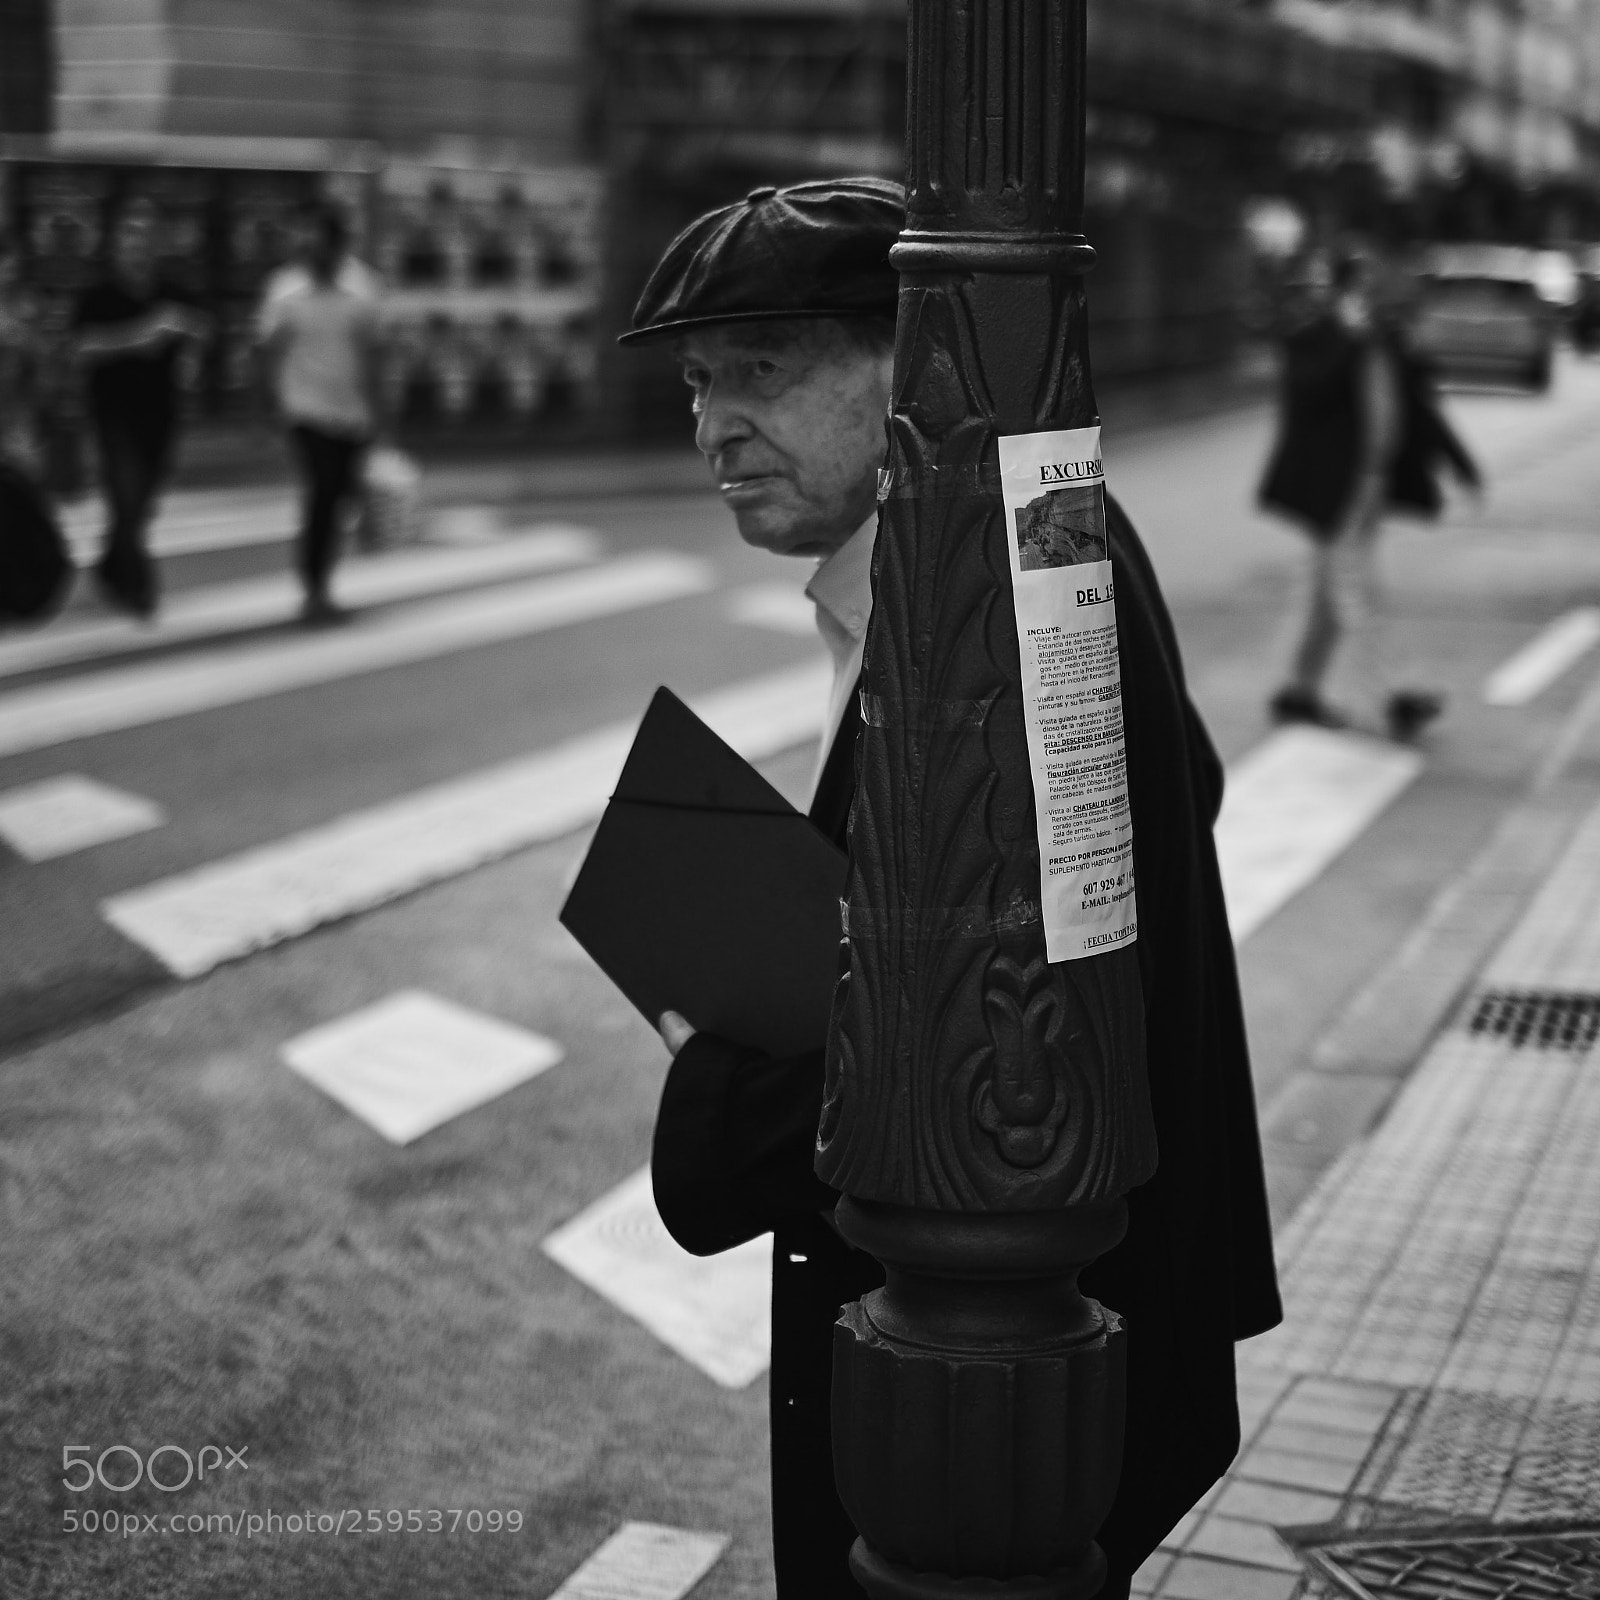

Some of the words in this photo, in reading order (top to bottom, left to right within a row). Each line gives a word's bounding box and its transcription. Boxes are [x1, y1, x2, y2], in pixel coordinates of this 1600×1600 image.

[1076, 588, 1101, 607] DEL
[1027, 627, 1061, 635] INCLUYE:
[1059, 655, 1077, 663] guiada
[1049, 670, 1072, 678] hombre
[1066, 690, 1085, 699] español
[1038, 702, 1063, 711] pinturas
[1059, 715, 1077, 724] guiada
[1062, 734, 1093, 746] DESCENSO
[1045, 744, 1080, 756] (capacidad
[1095, 740, 1106, 748] para
[1047, 767, 1079, 778] figuración
[1059, 777, 1075, 785] piedra
[1062, 791, 1084, 799] cabezas
[1048, 807, 1064, 816] Visita
[1073, 802, 1099, 813] CHATEAU
[1101, 799, 1107, 807] DE
[1049, 855, 1076, 865] PRECIO
[1078, 852, 1090, 860] POR
[1092, 846, 1117, 858] PERSONA
[1049, 863, 1090, 875] SUPLEMENTO
[1083, 882, 1097, 895] 607
[1100, 878, 1115, 891] 929
[1082, 897, 1110, 909] E-MAIL:
[1088, 934, 1113, 946] FECHA
